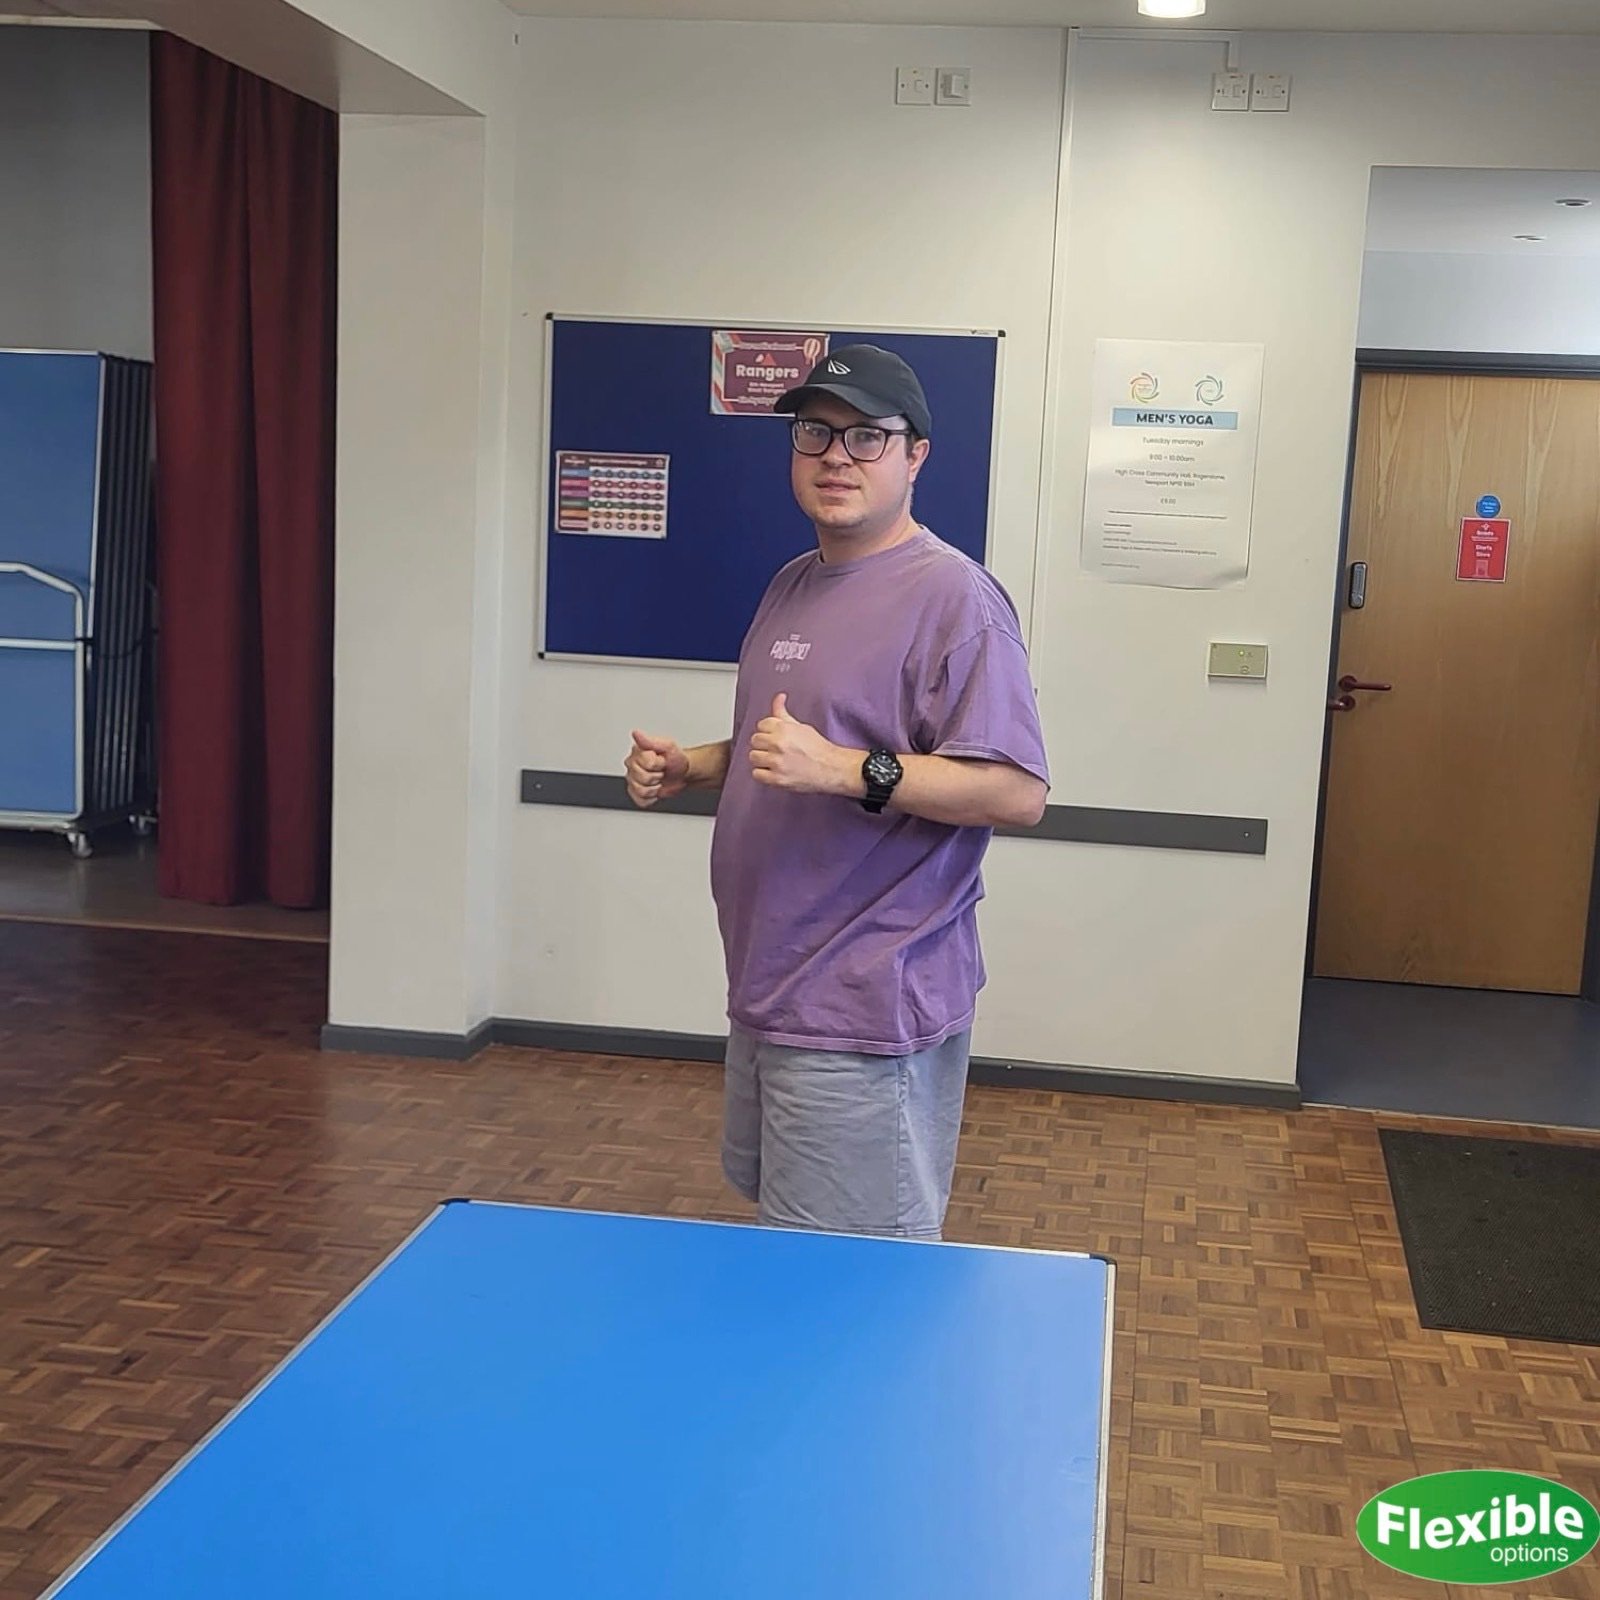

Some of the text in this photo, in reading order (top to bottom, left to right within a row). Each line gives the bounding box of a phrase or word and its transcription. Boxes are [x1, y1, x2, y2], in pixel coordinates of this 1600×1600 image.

[735, 364, 800, 381] Rangers
[1136, 413, 1214, 426] MEN'S YOGA
[1142, 436, 1204, 447] Tuesday mornings
[1146, 471, 1179, 479] Community
